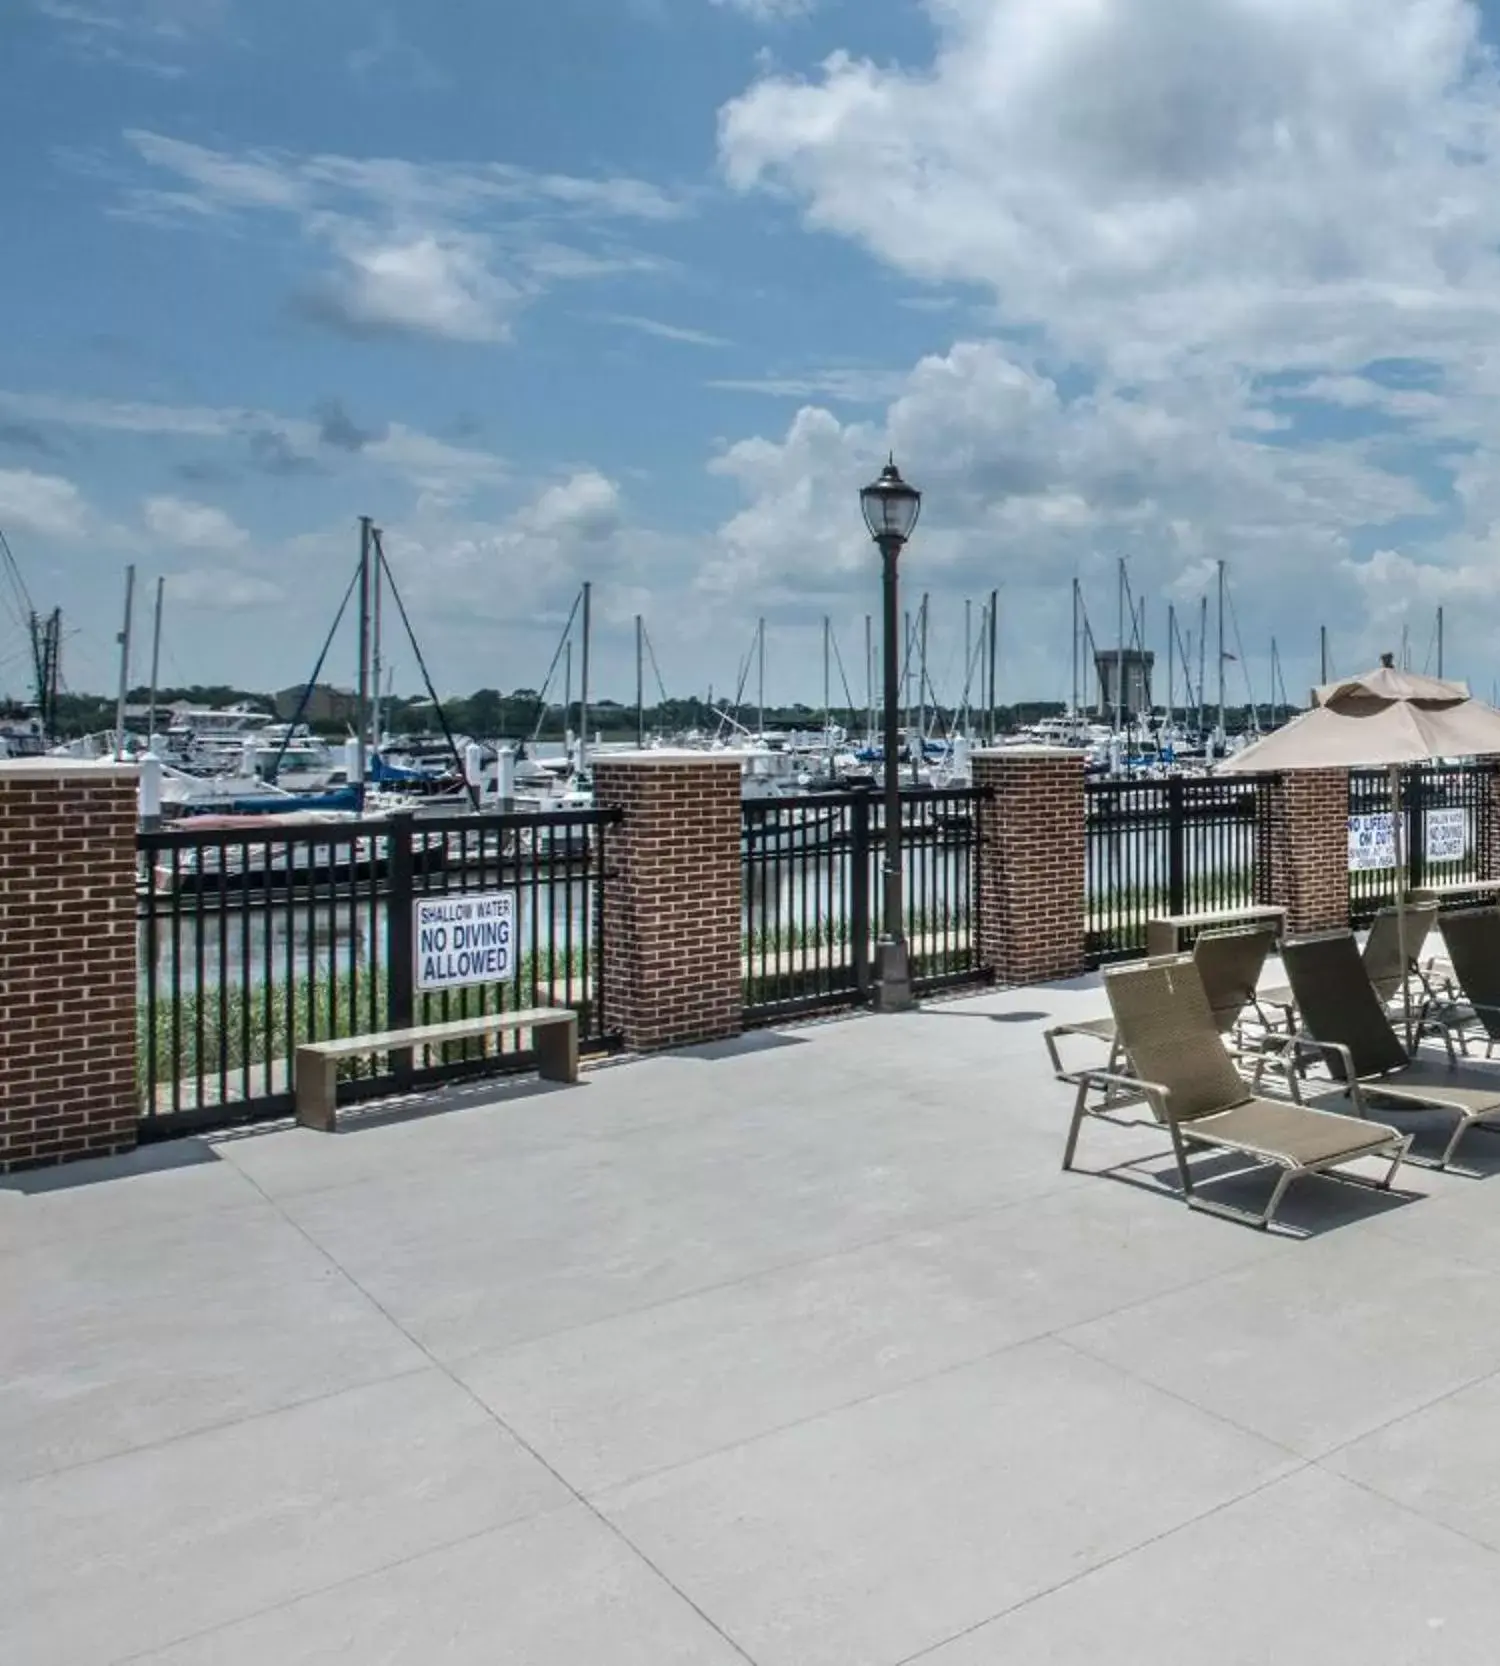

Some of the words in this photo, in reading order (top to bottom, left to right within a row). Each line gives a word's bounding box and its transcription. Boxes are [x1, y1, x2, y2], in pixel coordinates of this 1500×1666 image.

[477, 899, 510, 918] WATER
[421, 927, 447, 954] NO
[453, 921, 509, 949] DIVING
[423, 948, 507, 981] ALLOWED
